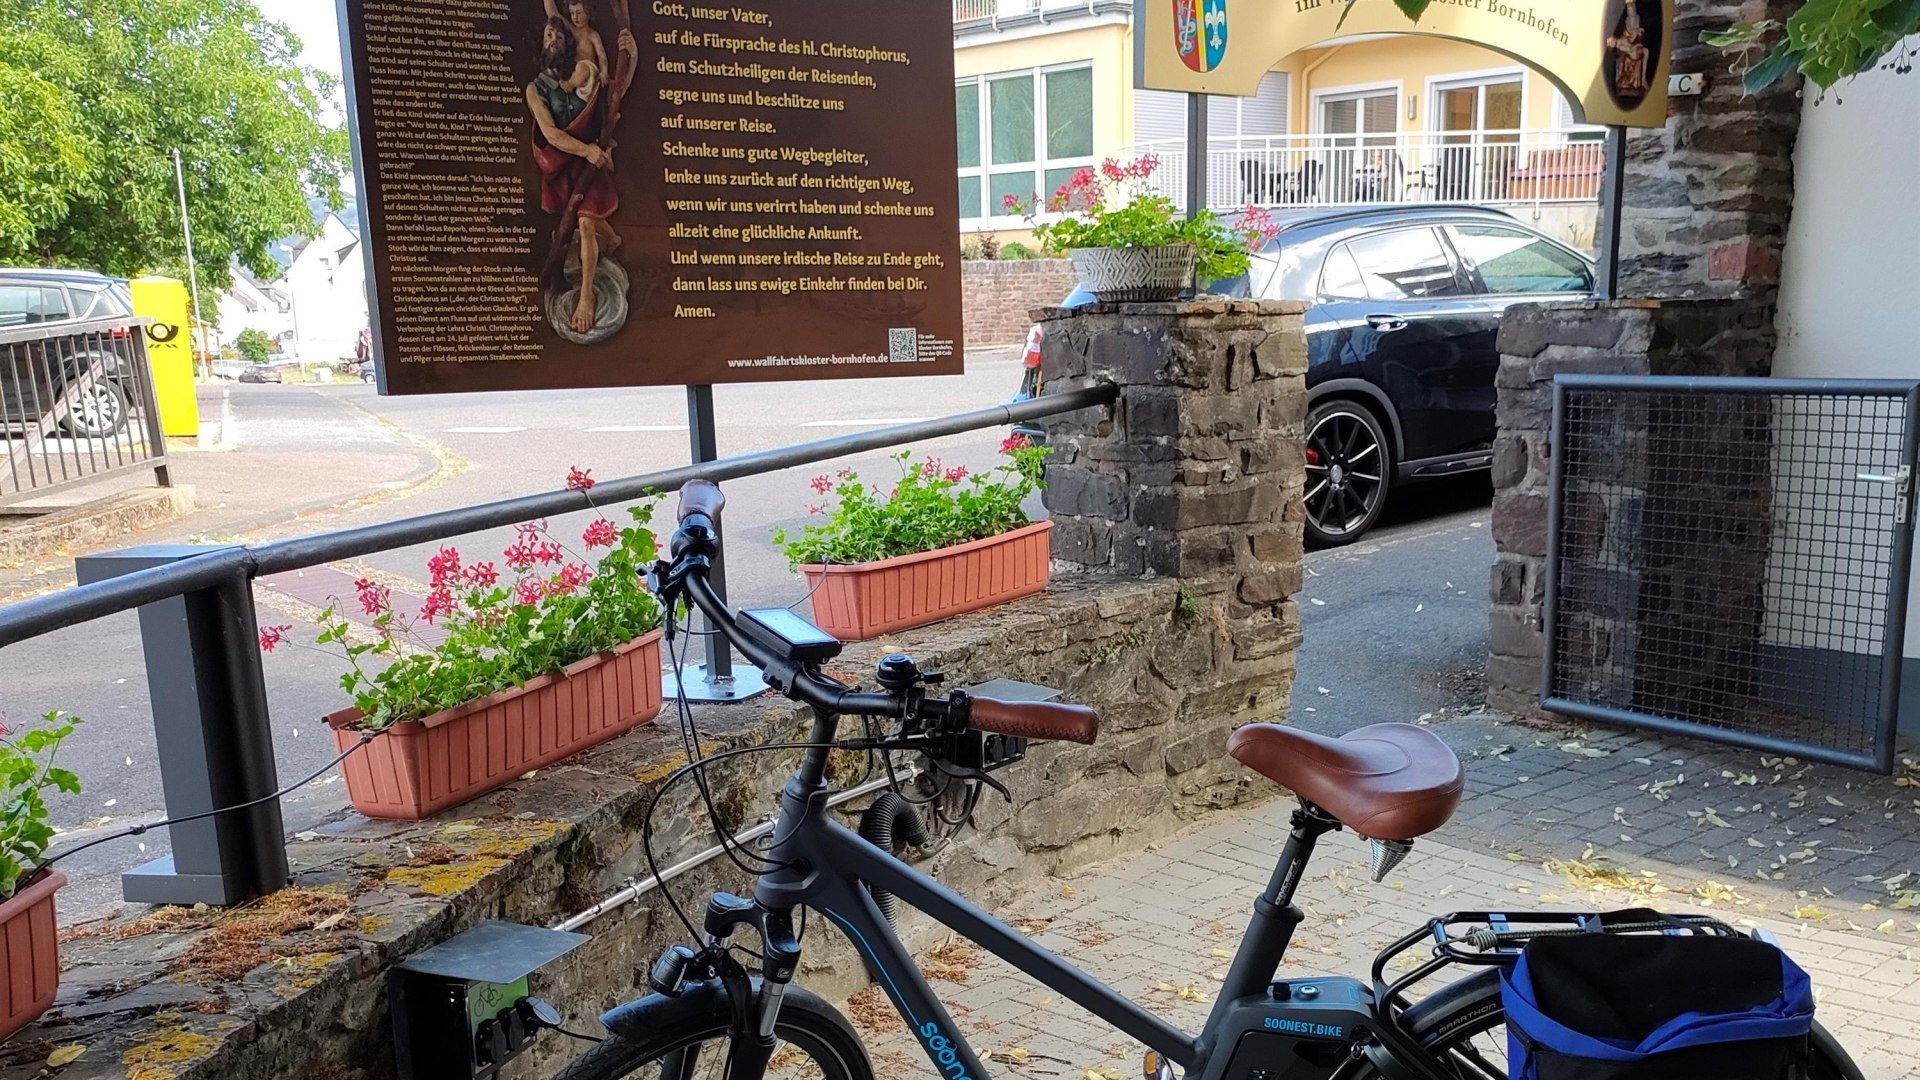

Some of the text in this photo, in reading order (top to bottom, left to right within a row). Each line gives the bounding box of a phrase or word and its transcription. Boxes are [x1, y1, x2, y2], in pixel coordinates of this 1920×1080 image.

[652, 0, 772, 27] Gott, unser Vater,
[1487, 0, 1569, 45] Bornhofen
[654, 30, 909, 65] auf die Fürsprache des hl. Christophorus,
[656, 57, 876, 88] dem Schutzheiligen der Reisenden,
[659, 89, 844, 110] segne uns und beschütze uns
[660, 114, 776, 133] auf unserer Reise.
[662, 141, 868, 166] Schenke uns gute Wegbegleiter,
[664, 168, 913, 194] lenke uns zurück auf den richtigen Weg,
[666, 197, 934, 216] wenn wir uns verirrt haben und schenke uns
[668, 223, 862, 242] allzeit eine glückliche Ankunft.
[432, 264, 457, 273] Morgen
[458, 265, 471, 273] fing
[670, 250, 943, 269] Und wenn unsere irdische Reise zu Ende geht,
[672, 276, 927, 294] dann lass uns ewige Einkehr finden bei Dir.
[408, 305, 433, 313] festigte
[527, 304, 538, 312] gab
[674, 304, 715, 317] Amen.
[395, 325, 435, 333] Verbreitung
[488, 324, 533, 332] Christophorus,
[469, 334, 493, 342] gefeiert
[413, 355, 431, 363] Pilger
[727, 352, 888, 367] www.wallfahrtskloster-bornhofen.de
[1264, 1017, 1343, 1037] SOONEST.BIKE
[1439, 1003, 1497, 1034] MARATHON
[920, 1022, 972, 1080] soon
